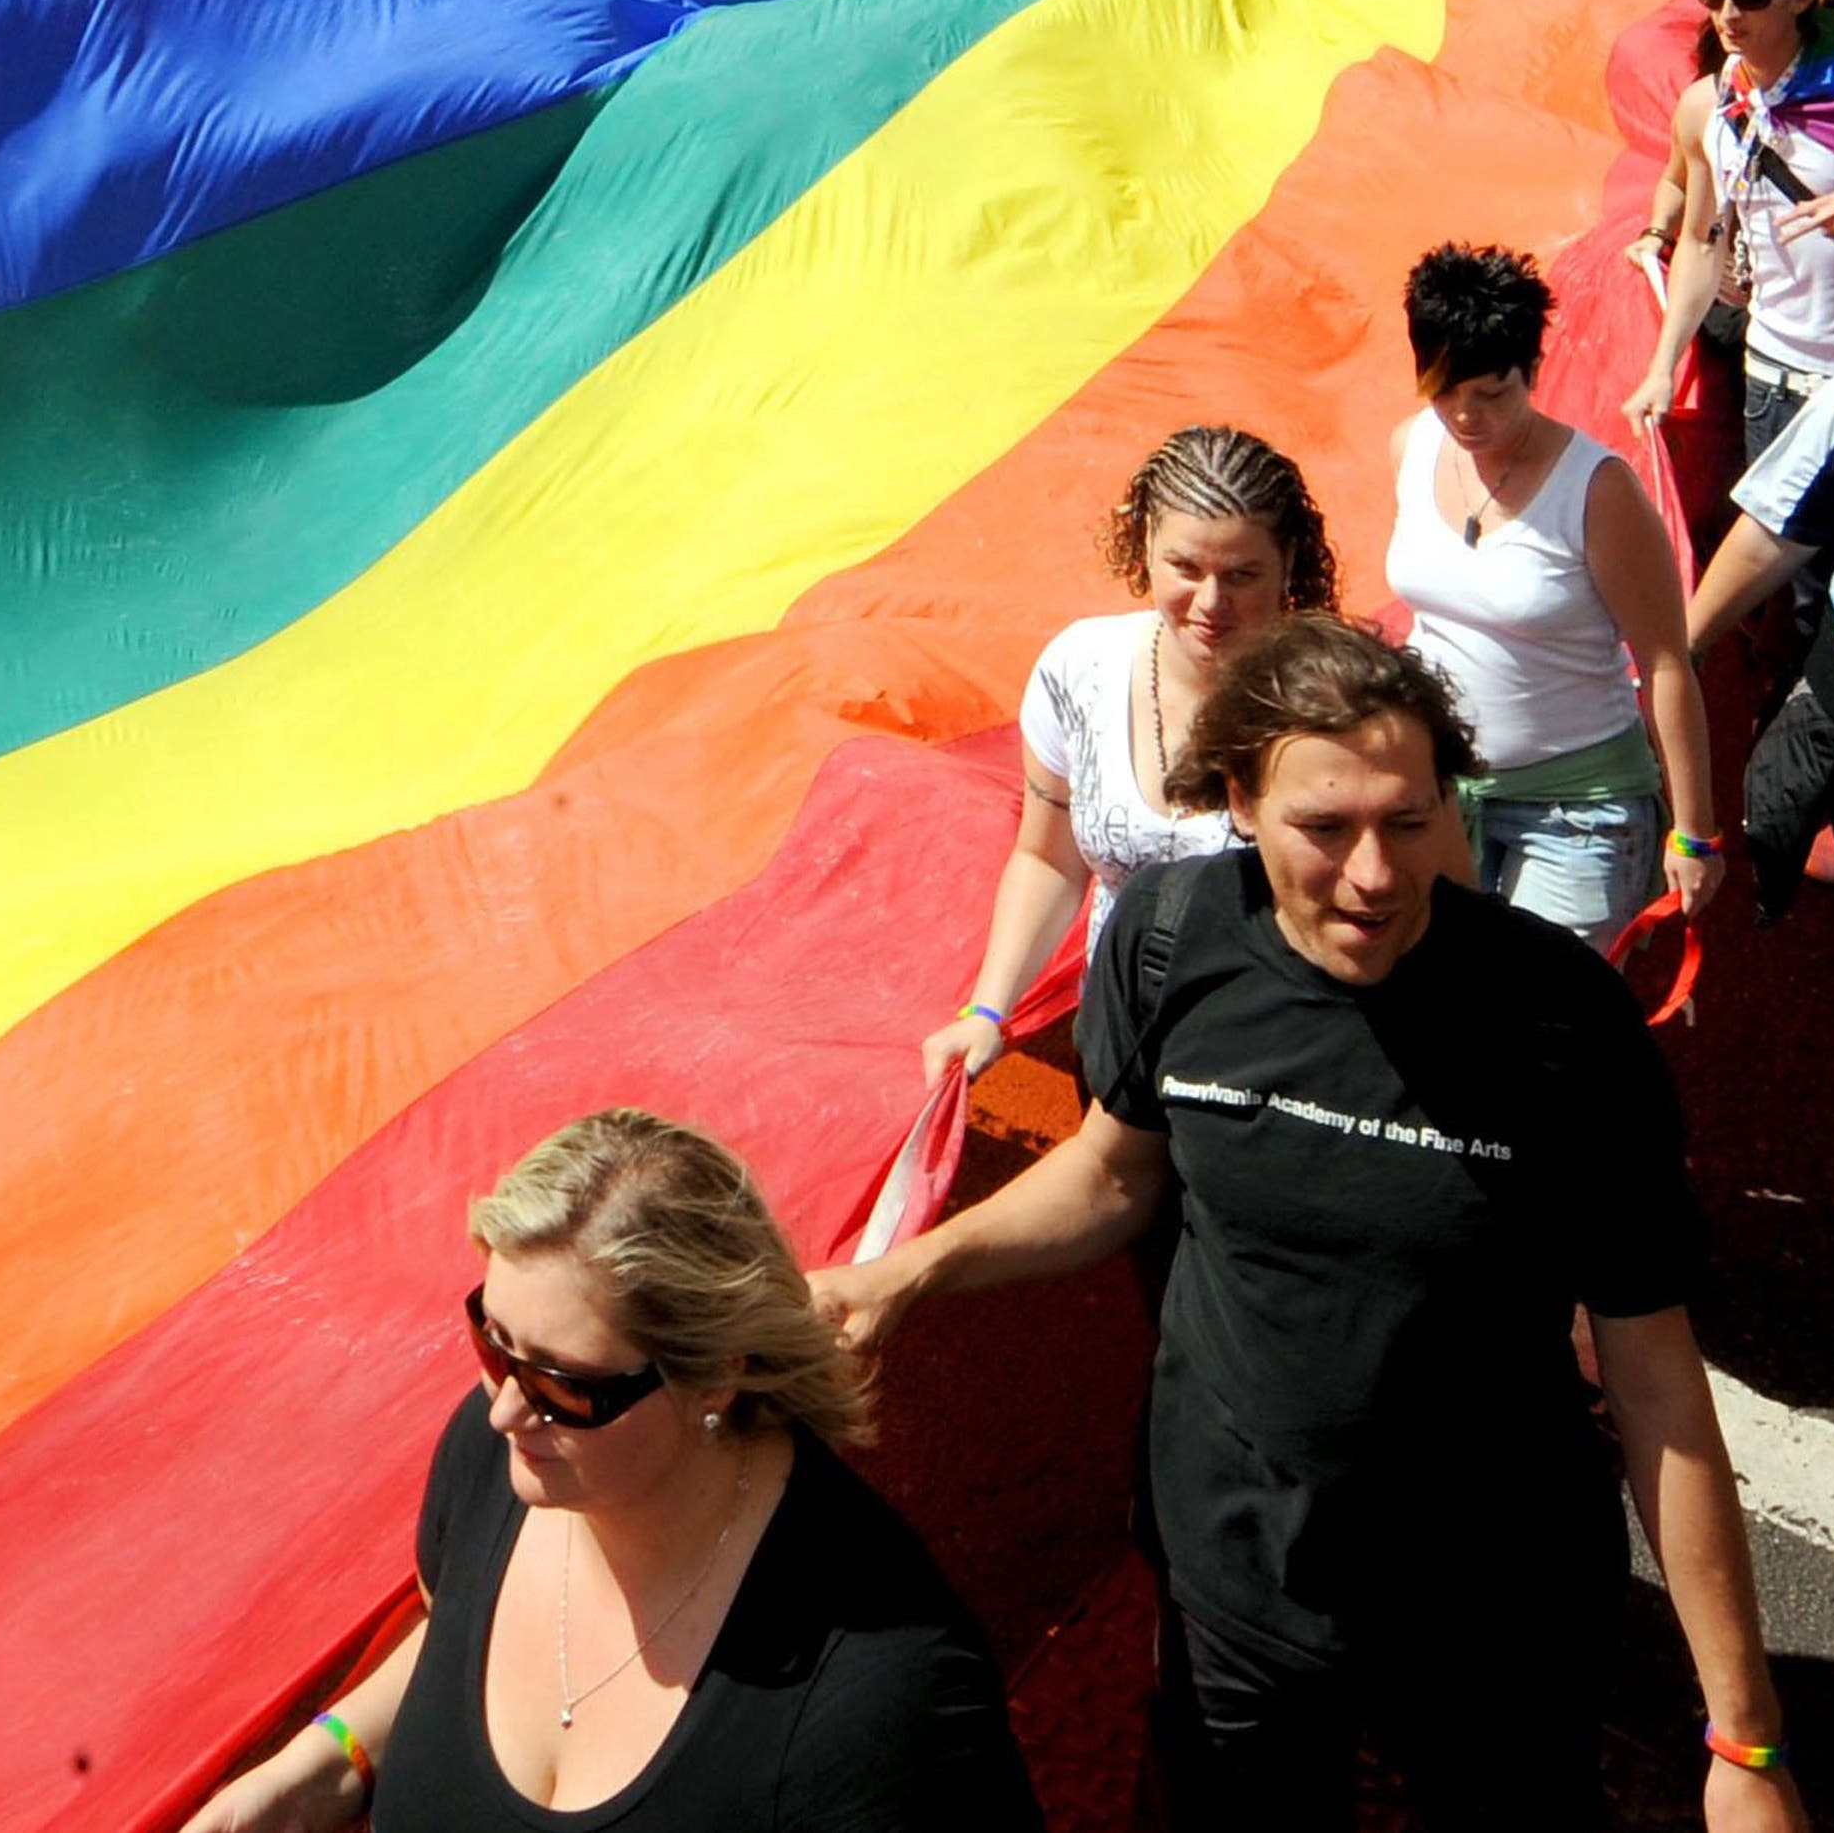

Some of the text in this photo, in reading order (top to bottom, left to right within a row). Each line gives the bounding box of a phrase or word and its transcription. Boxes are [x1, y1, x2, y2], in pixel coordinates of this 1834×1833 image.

[1162, 1074, 1513, 1161] Pennsylvania Academy of the Fine Arts
